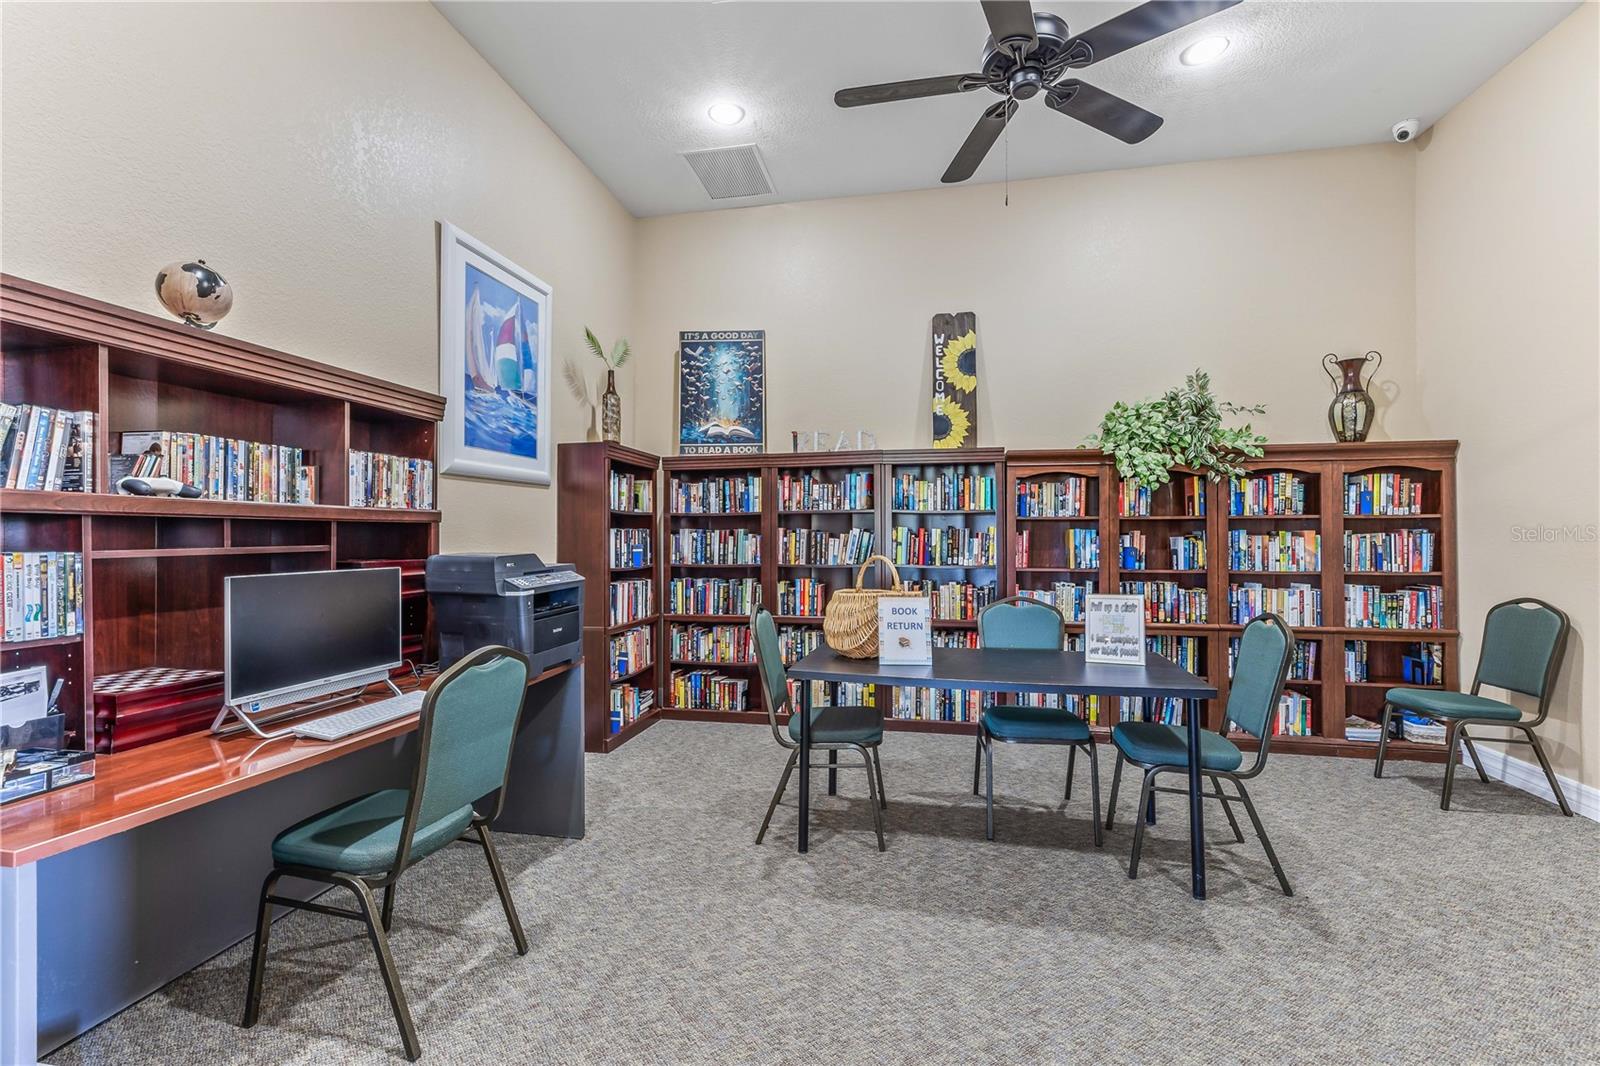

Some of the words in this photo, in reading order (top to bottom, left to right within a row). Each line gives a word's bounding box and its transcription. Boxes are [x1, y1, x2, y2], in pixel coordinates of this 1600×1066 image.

[684, 332, 700, 340] IT'S
[701, 332, 709, 340] A
[710, 332, 739, 340] GOOD
[740, 331, 759, 339] DAY
[934, 333, 945, 416] WELCOME
[684, 446, 696, 454] TO
[698, 446, 722, 454] READ
[723, 446, 731, 454] A
[732, 445, 759, 453] BOOK
[891, 607, 918, 615] BOOK
[887, 622, 924, 630] RETURN
